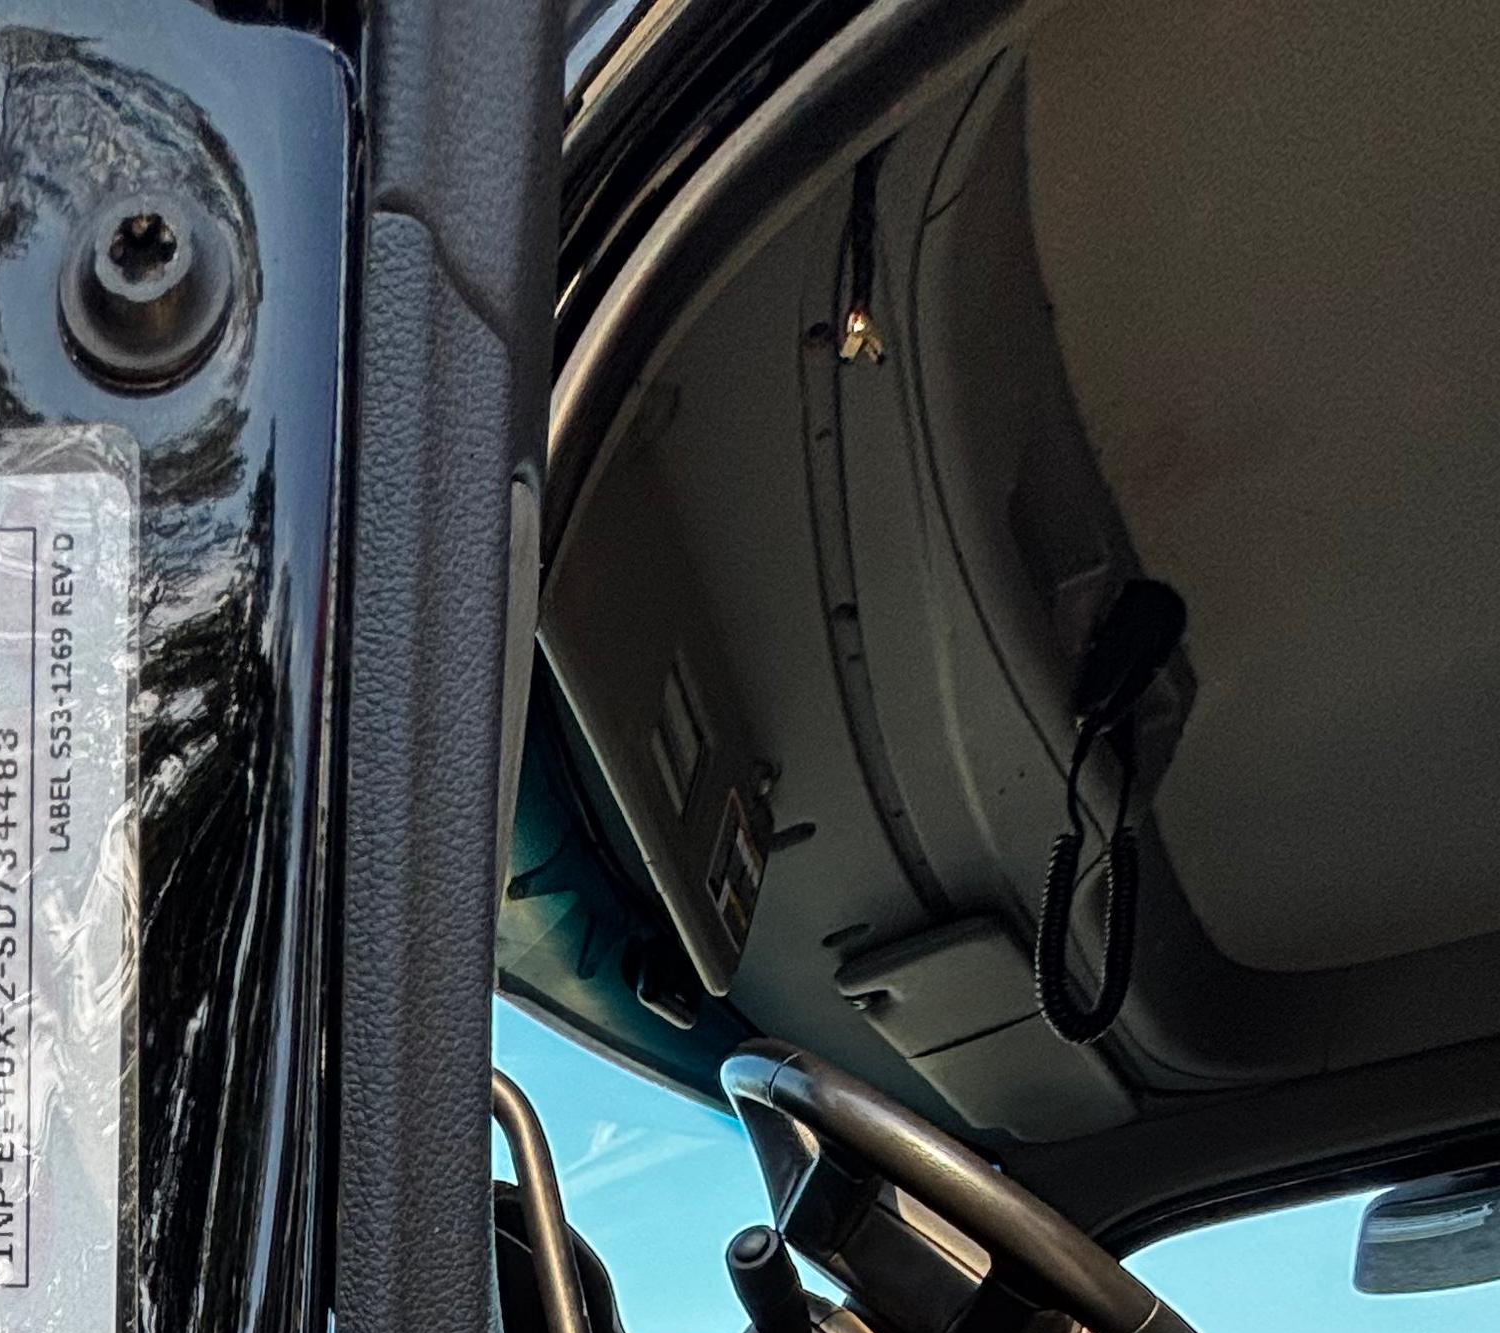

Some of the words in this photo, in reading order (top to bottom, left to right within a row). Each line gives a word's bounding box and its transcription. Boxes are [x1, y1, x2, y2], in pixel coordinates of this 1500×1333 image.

[52, 532, 74, 551] D
[49, 563, 73, 616] REV
[49, 627, 73, 758] S53-1269
[48, 768, 72, 853] LABEL
